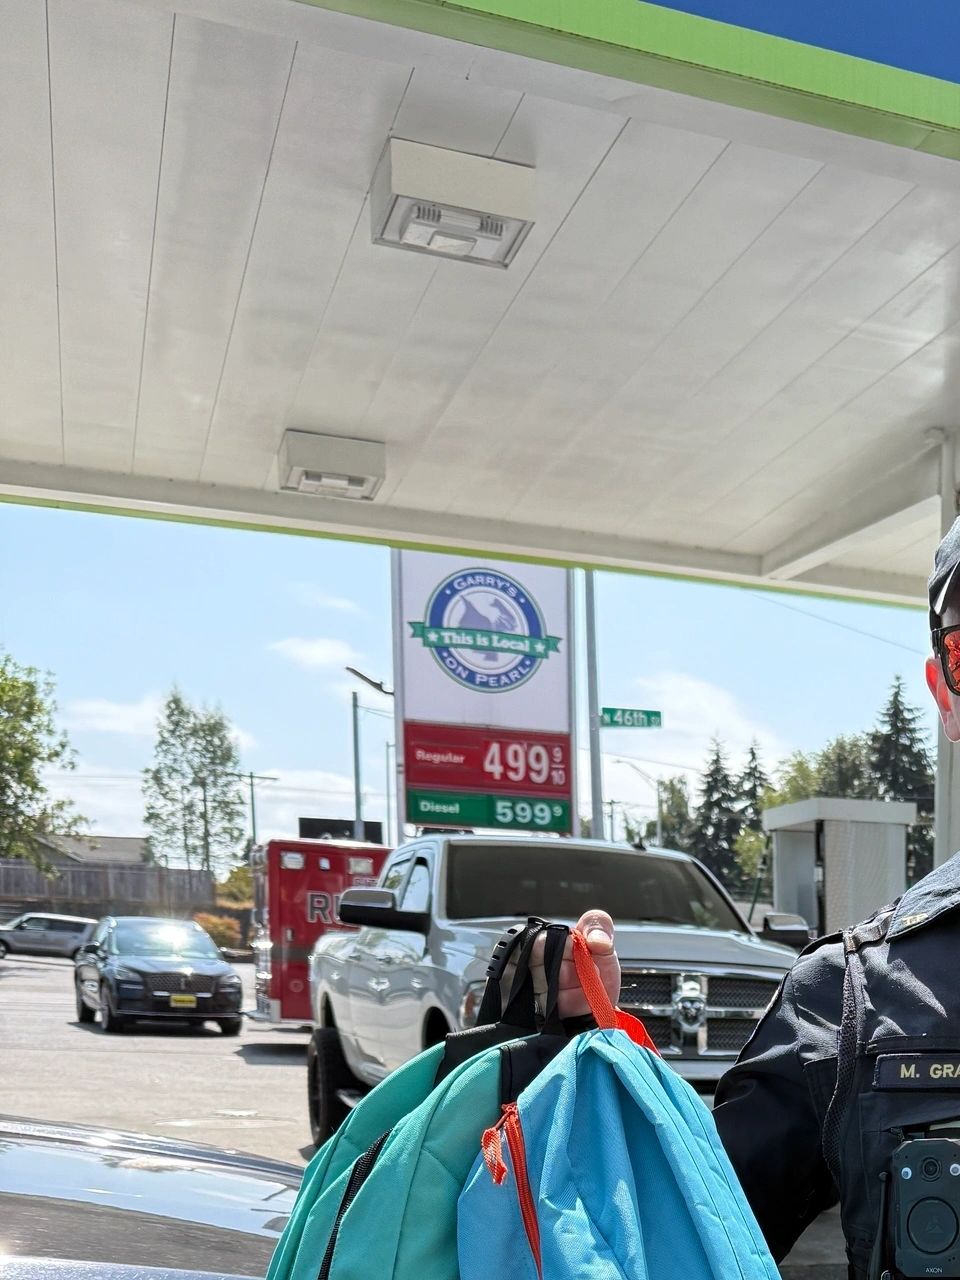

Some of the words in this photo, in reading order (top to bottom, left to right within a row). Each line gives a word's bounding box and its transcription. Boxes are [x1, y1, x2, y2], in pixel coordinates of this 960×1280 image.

[453, 574, 518, 597] GARRY'S
[440, 632, 473, 645] This
[477, 634, 488, 646] is
[492, 635, 530, 651] Local
[445, 657, 469, 679] ON
[475, 665, 530, 687] PEARL
[613, 709, 648, 726] 46th
[415, 750, 466, 764] Regular
[419, 801, 460, 814] Diesel
[900, 1063, 920, 1079] M.
